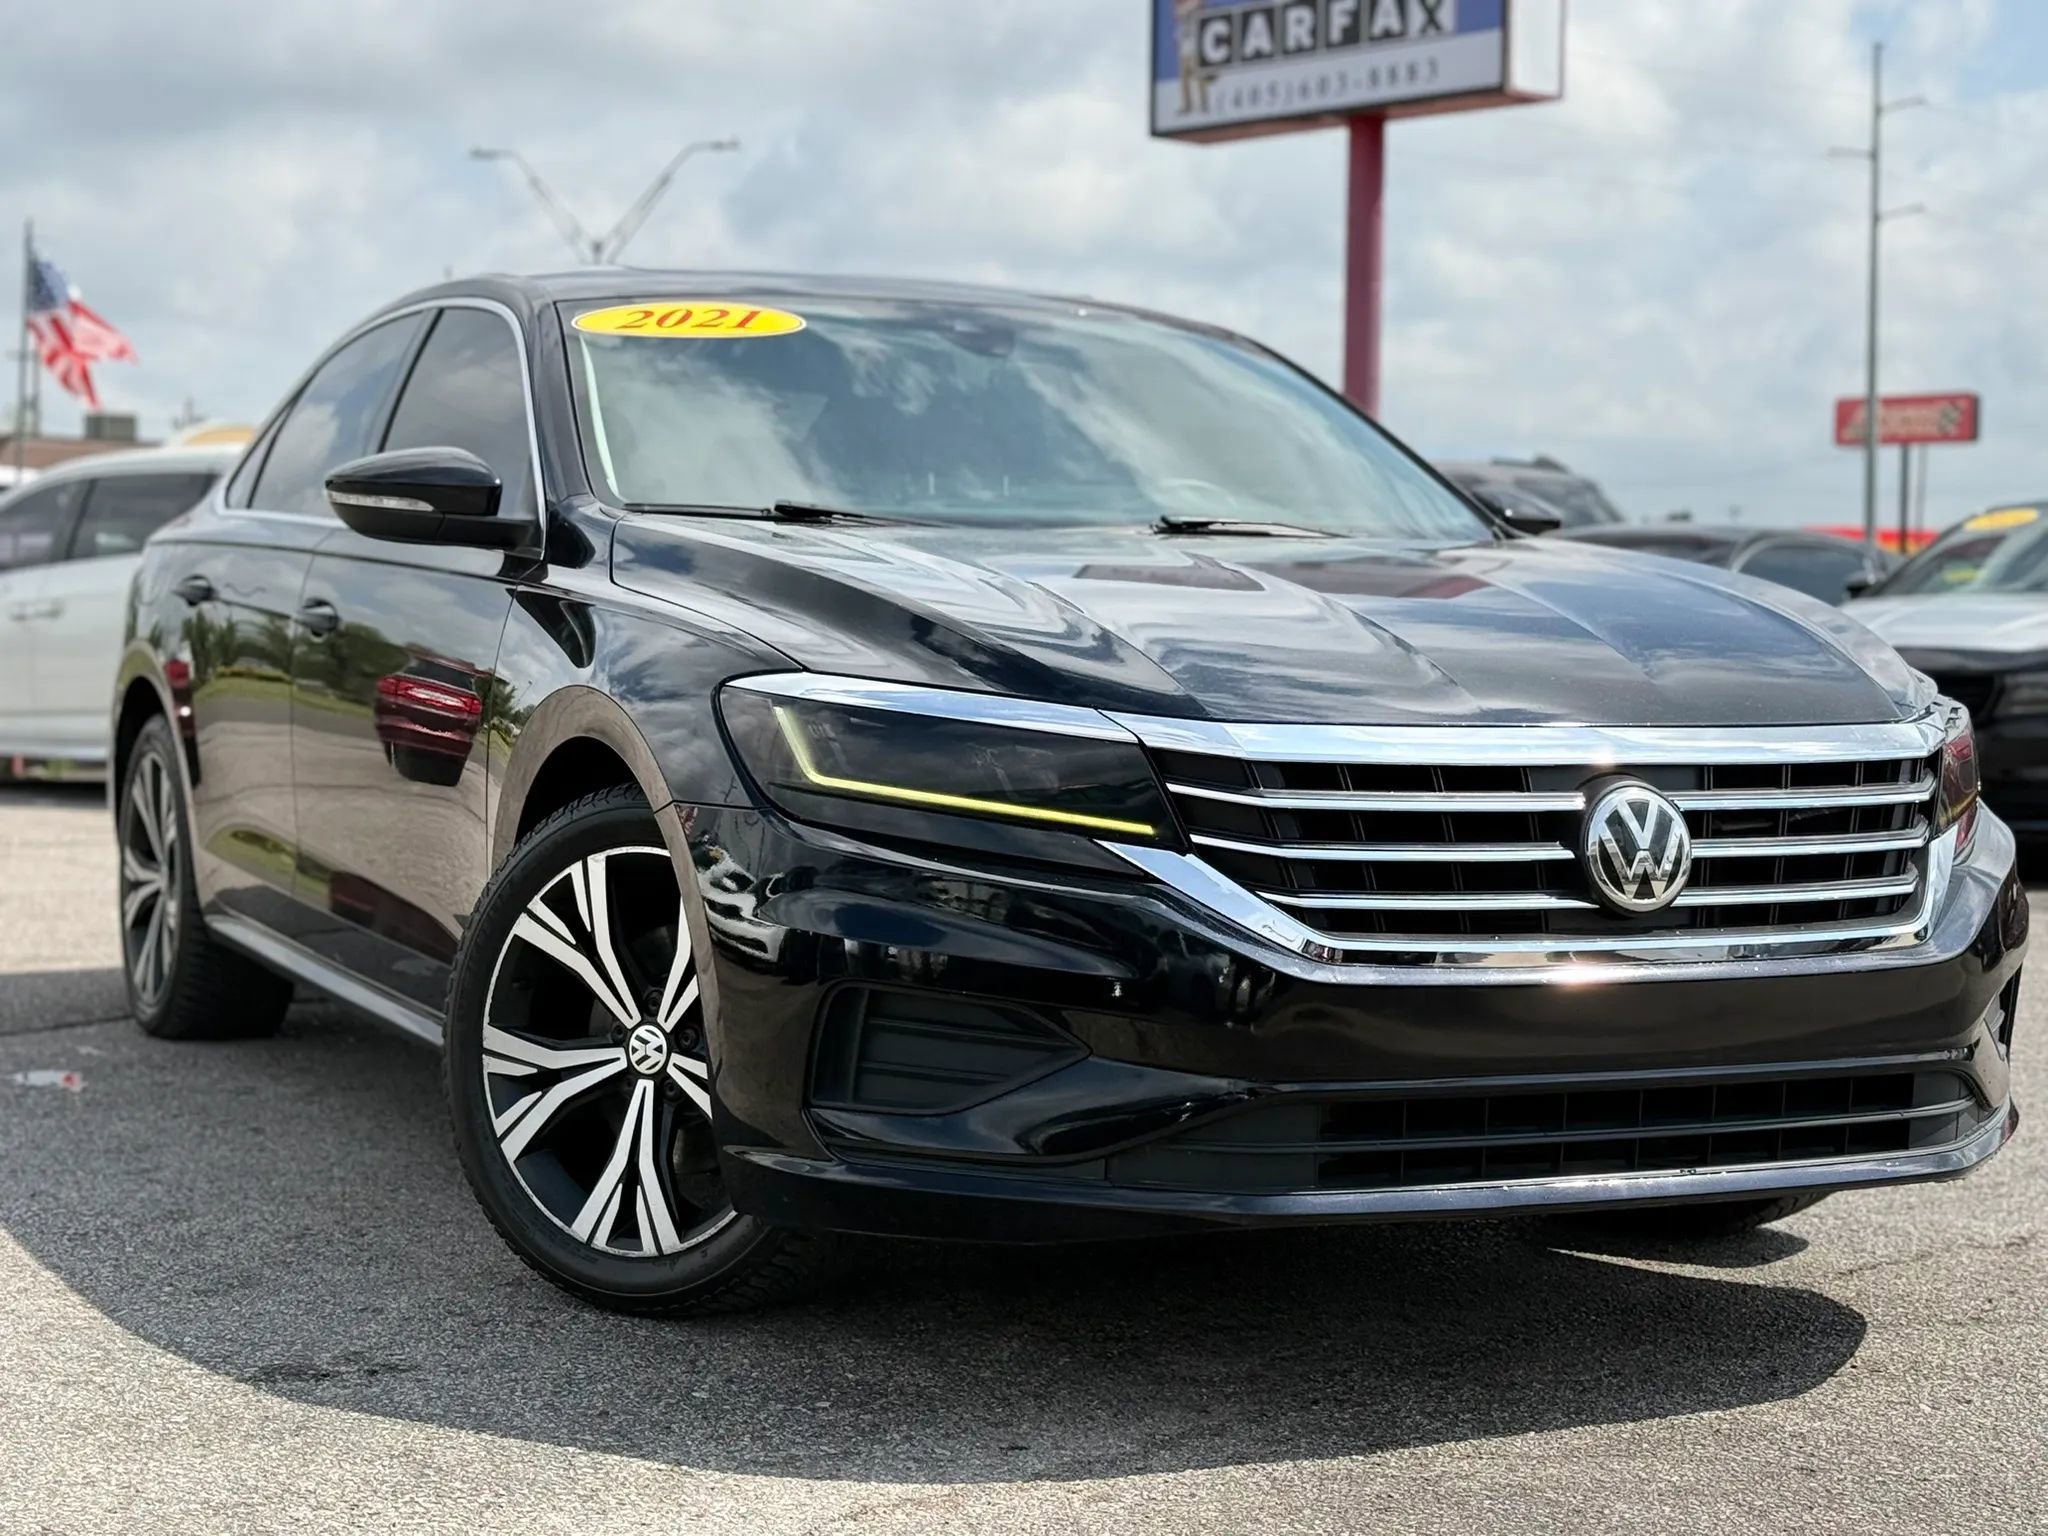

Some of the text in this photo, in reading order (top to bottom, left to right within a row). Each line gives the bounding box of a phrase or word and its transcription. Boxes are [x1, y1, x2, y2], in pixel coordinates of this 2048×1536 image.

[1201, 0, 1446, 64] CARFAX
[614, 308, 760, 329] 2021
[1590, 785, 1688, 907] VW
